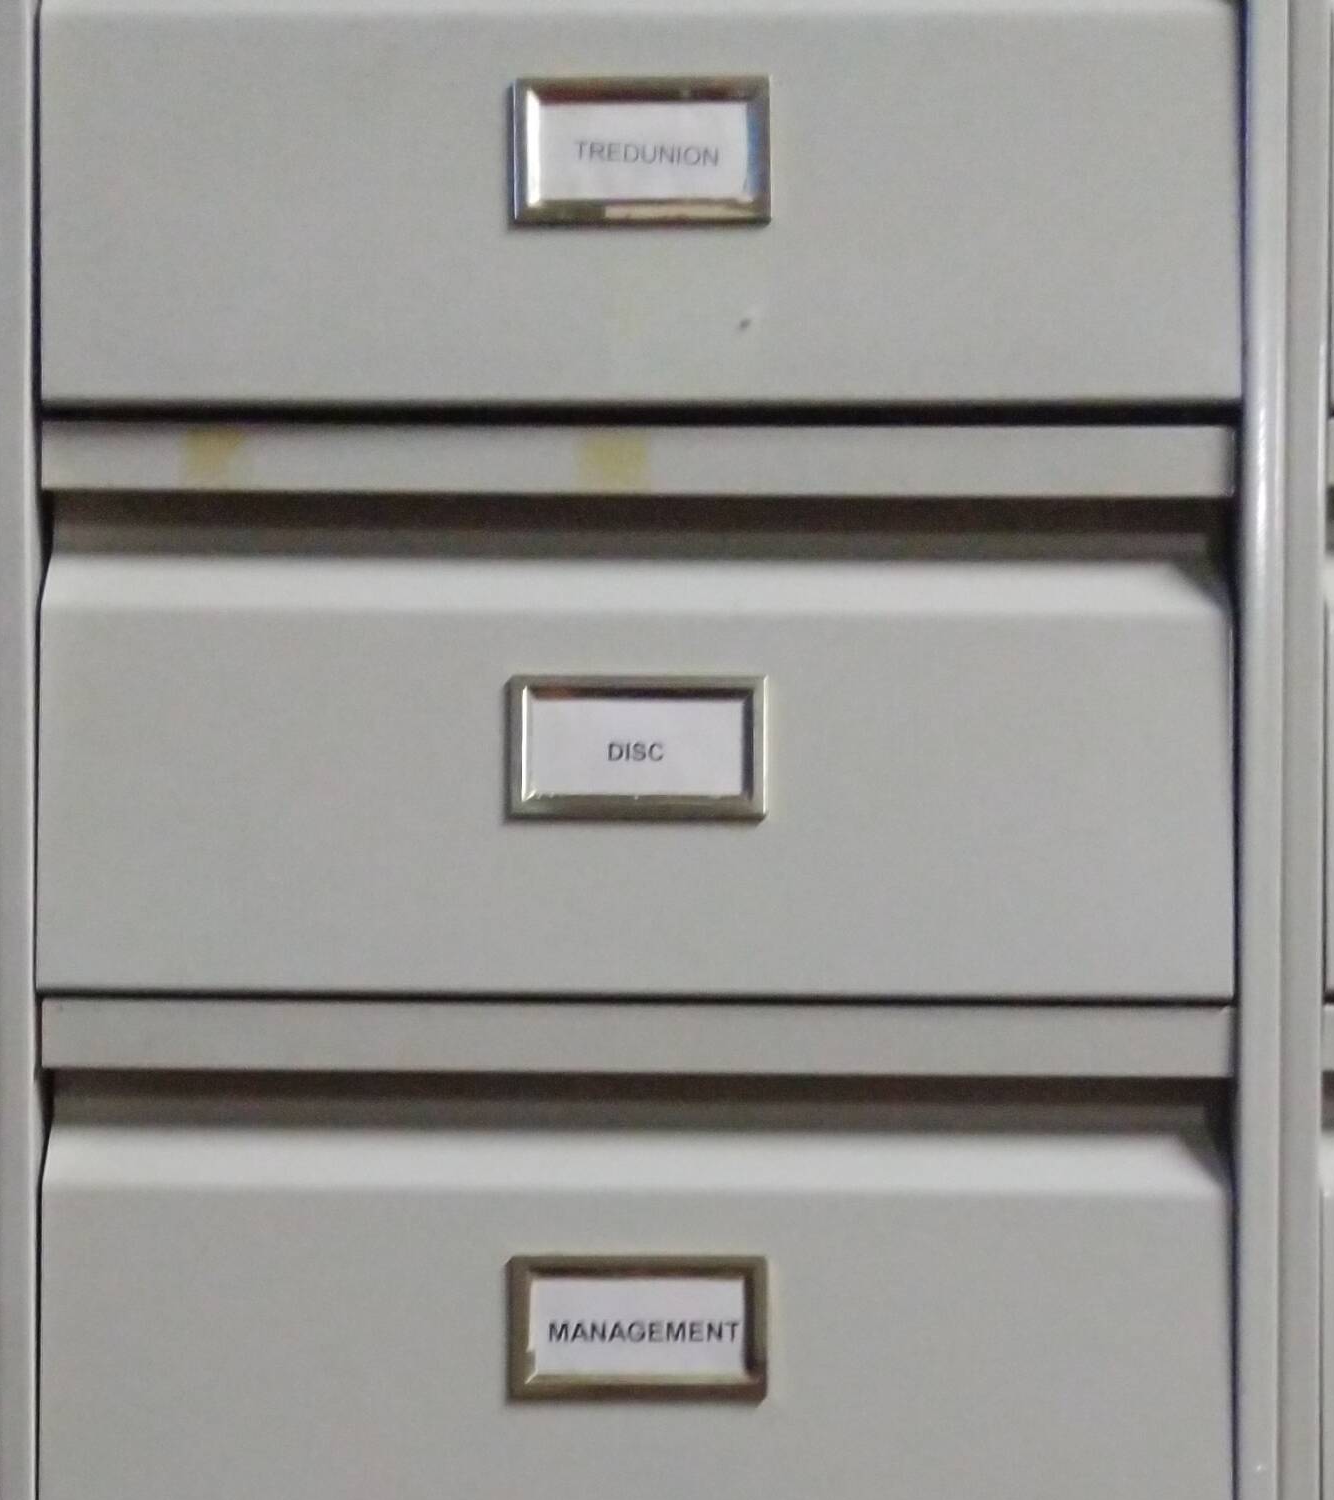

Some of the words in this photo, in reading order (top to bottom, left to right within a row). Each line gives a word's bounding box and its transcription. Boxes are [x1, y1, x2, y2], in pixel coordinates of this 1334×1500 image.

[576, 141, 718, 167] TREDUNION
[607, 742, 664, 761] DISC
[548, 1321, 740, 1343] MANAGEMENT
